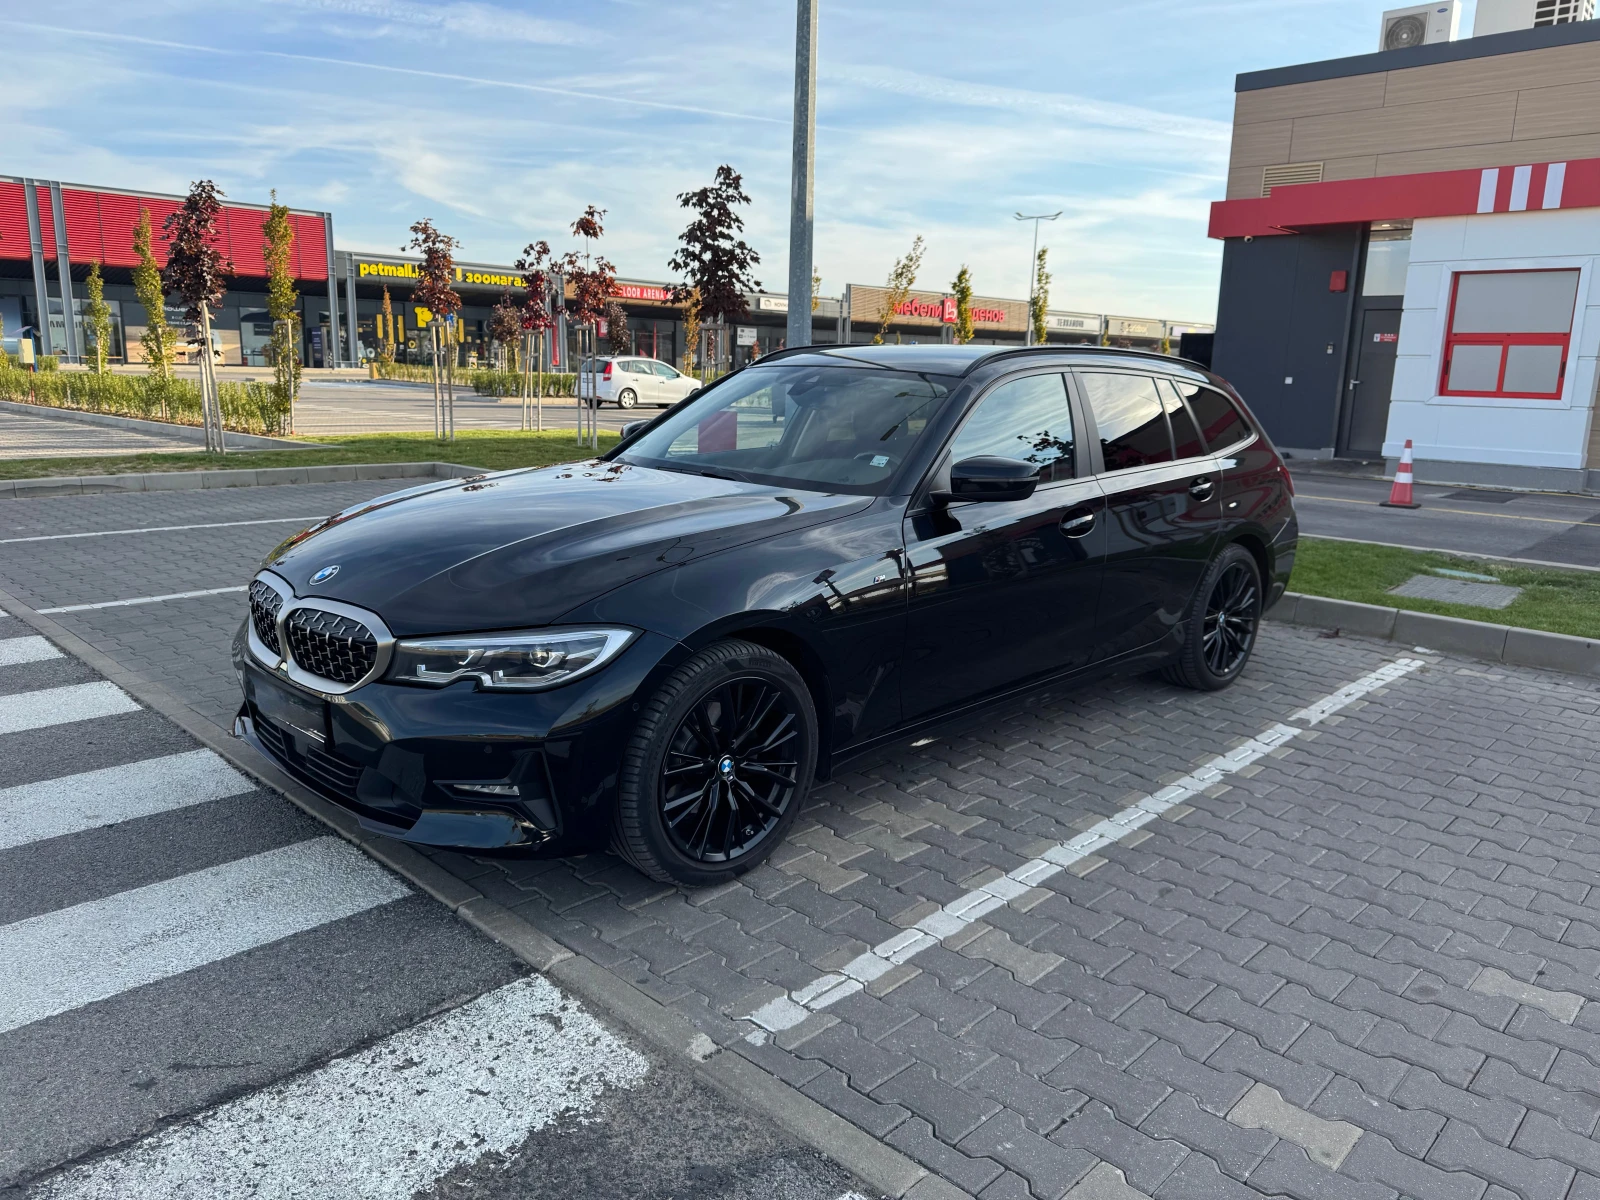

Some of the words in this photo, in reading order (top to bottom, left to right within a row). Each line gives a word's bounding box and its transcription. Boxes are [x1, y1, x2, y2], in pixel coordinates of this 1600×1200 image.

[359, 263, 428, 279] petmall.b
[621, 286, 641, 298] LOOR
[643, 288, 665, 300] ARENA
[963, 307, 1005, 323] денов
